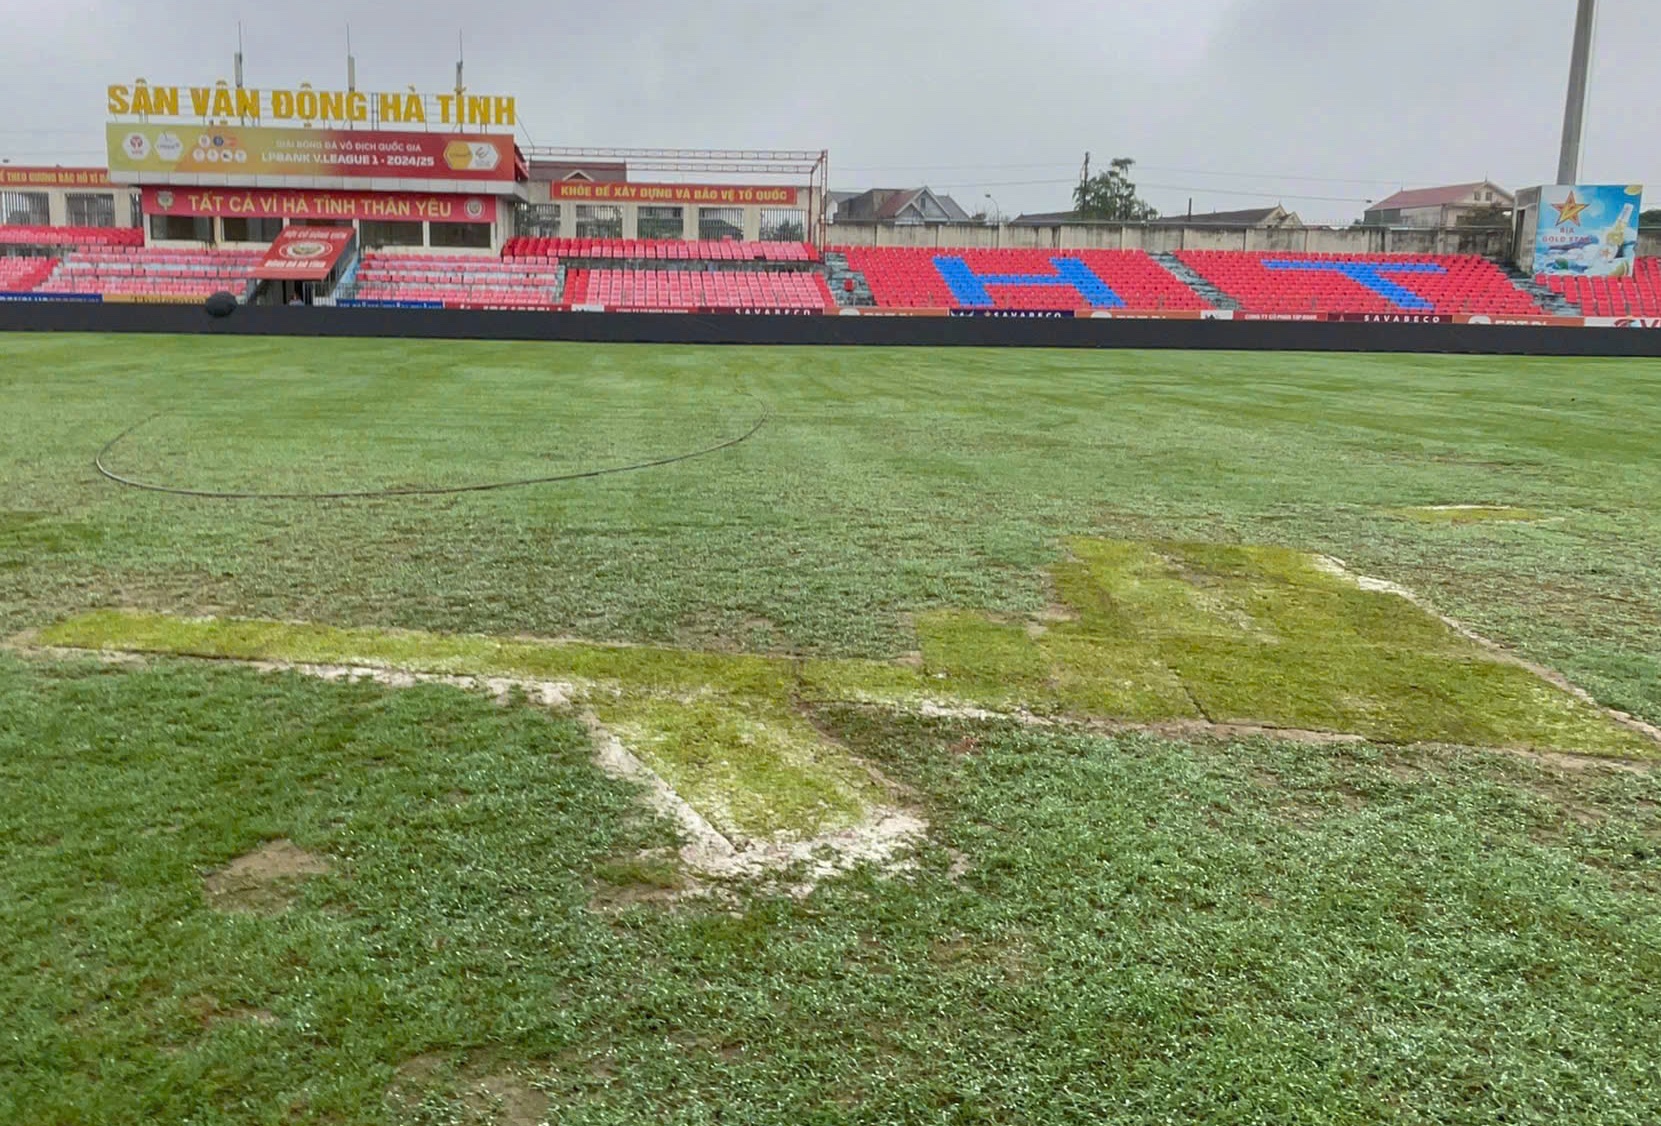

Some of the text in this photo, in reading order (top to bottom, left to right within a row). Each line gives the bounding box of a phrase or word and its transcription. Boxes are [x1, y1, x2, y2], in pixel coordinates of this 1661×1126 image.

[107, 77, 179, 115] SÂN
[190, 79, 260, 125] VẬN
[271, 82, 367, 128] ĐỘNG
[379, 85, 425, 122] HÀ
[406, 142, 422, 152] GIA
[262, 151, 309, 163] LPBANK
[312, 153, 370, 165] V.LEAGUE
[386, 155, 435, 167] 2024/25
[614, 184, 637, 197] XÂY
[188, 190, 223, 211] TẤT
[229, 192, 256, 212] CẢ
[283, 192, 309, 213] HÀ
[314, 194, 355, 216] TĨNH
[360, 196, 410, 217] THÂN
[416, 198, 452, 218] YÊU
[1363, 314, 1440, 323] SAVABECO
